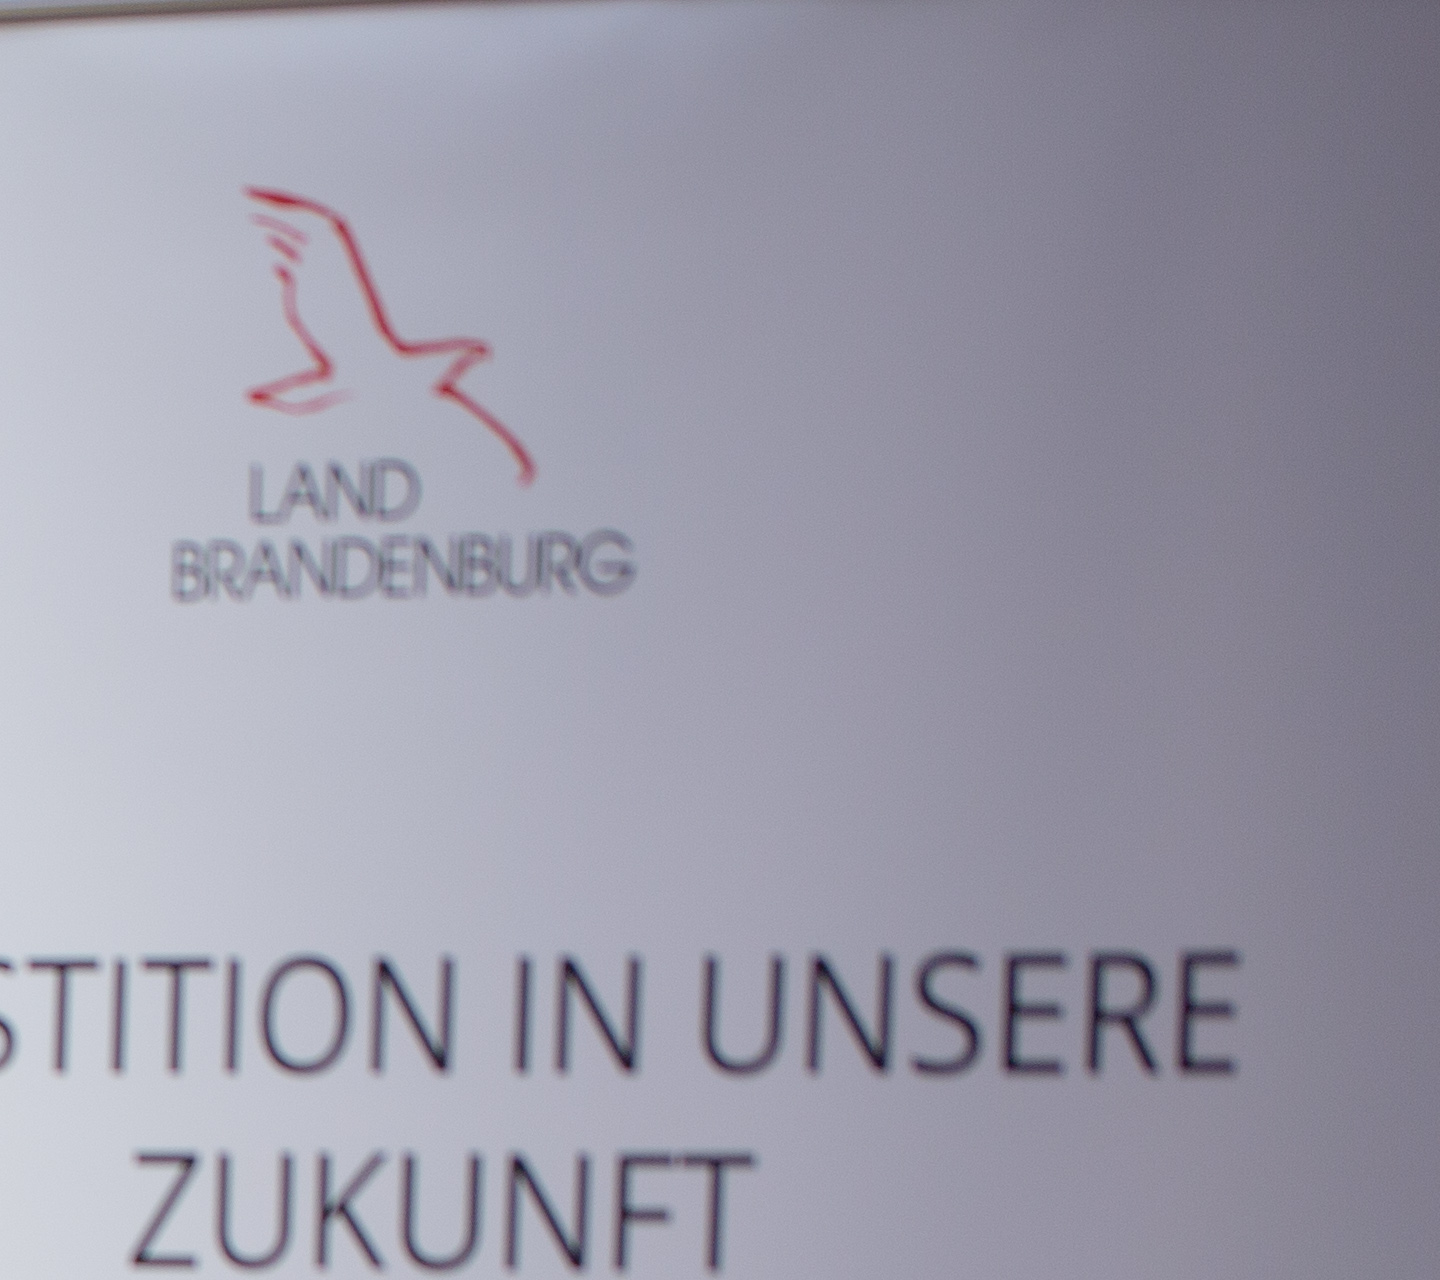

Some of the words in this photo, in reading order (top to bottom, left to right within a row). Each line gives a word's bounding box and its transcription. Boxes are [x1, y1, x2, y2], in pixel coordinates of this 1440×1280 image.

[247, 456, 423, 525] LAND
[170, 527, 638, 602] BRANDENBURG
[509, 953, 643, 1076] IN
[700, 948, 1243, 1077] UNSERE
[129, 1151, 757, 1273] ZUKUNFT
